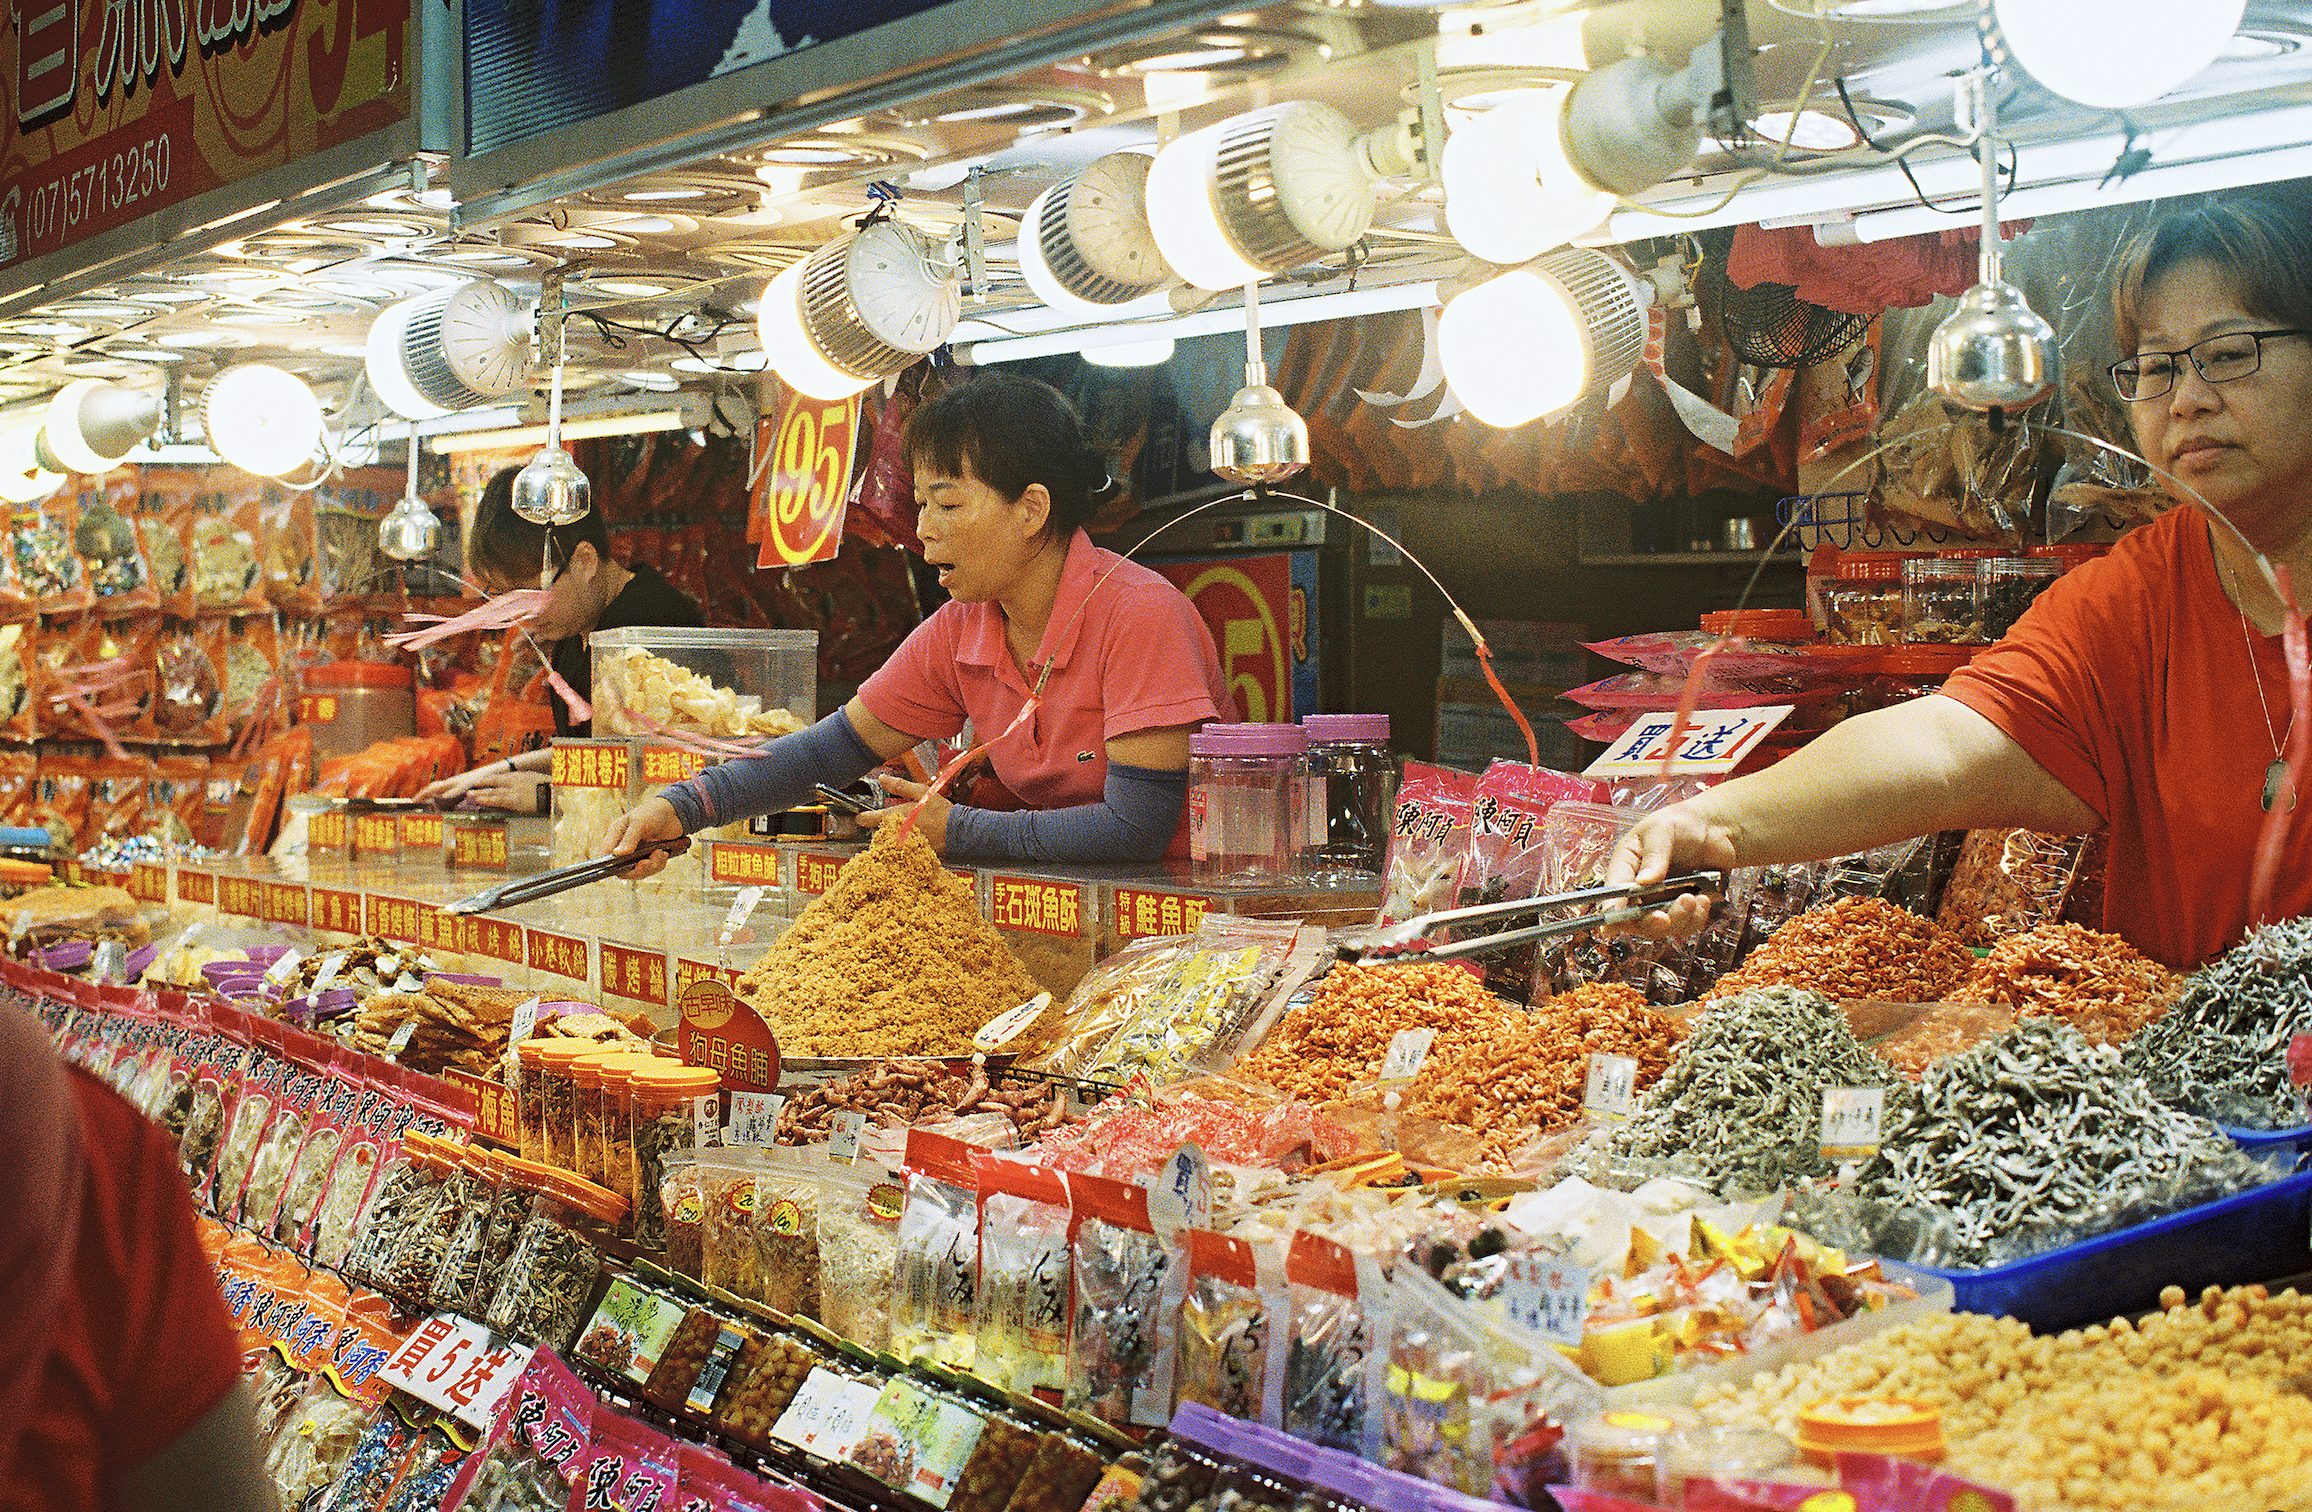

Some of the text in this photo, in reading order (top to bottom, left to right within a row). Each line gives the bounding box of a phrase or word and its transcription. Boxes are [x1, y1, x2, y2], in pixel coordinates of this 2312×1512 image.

[25, 132, 171, 257] (07)5713250
[778, 404, 848, 524] 95
[1613, 717, 1767, 761] 買5送1
[1395, 801, 1456, 847] 陳阿貞
[1473, 795, 1536, 850] 陳阿貞
[994, 882, 1006, 924] 手工
[1006, 883, 1079, 933] 石斑魚酥
[1134, 894, 1208, 936] 鮭魚酥
[684, 991, 734, 1018] 古早味
[688, 1030, 769, 1088] 狗母魚脯
[355, 1088, 394, 1142] 陳阿
[773, 1211, 791, 1231] 100
